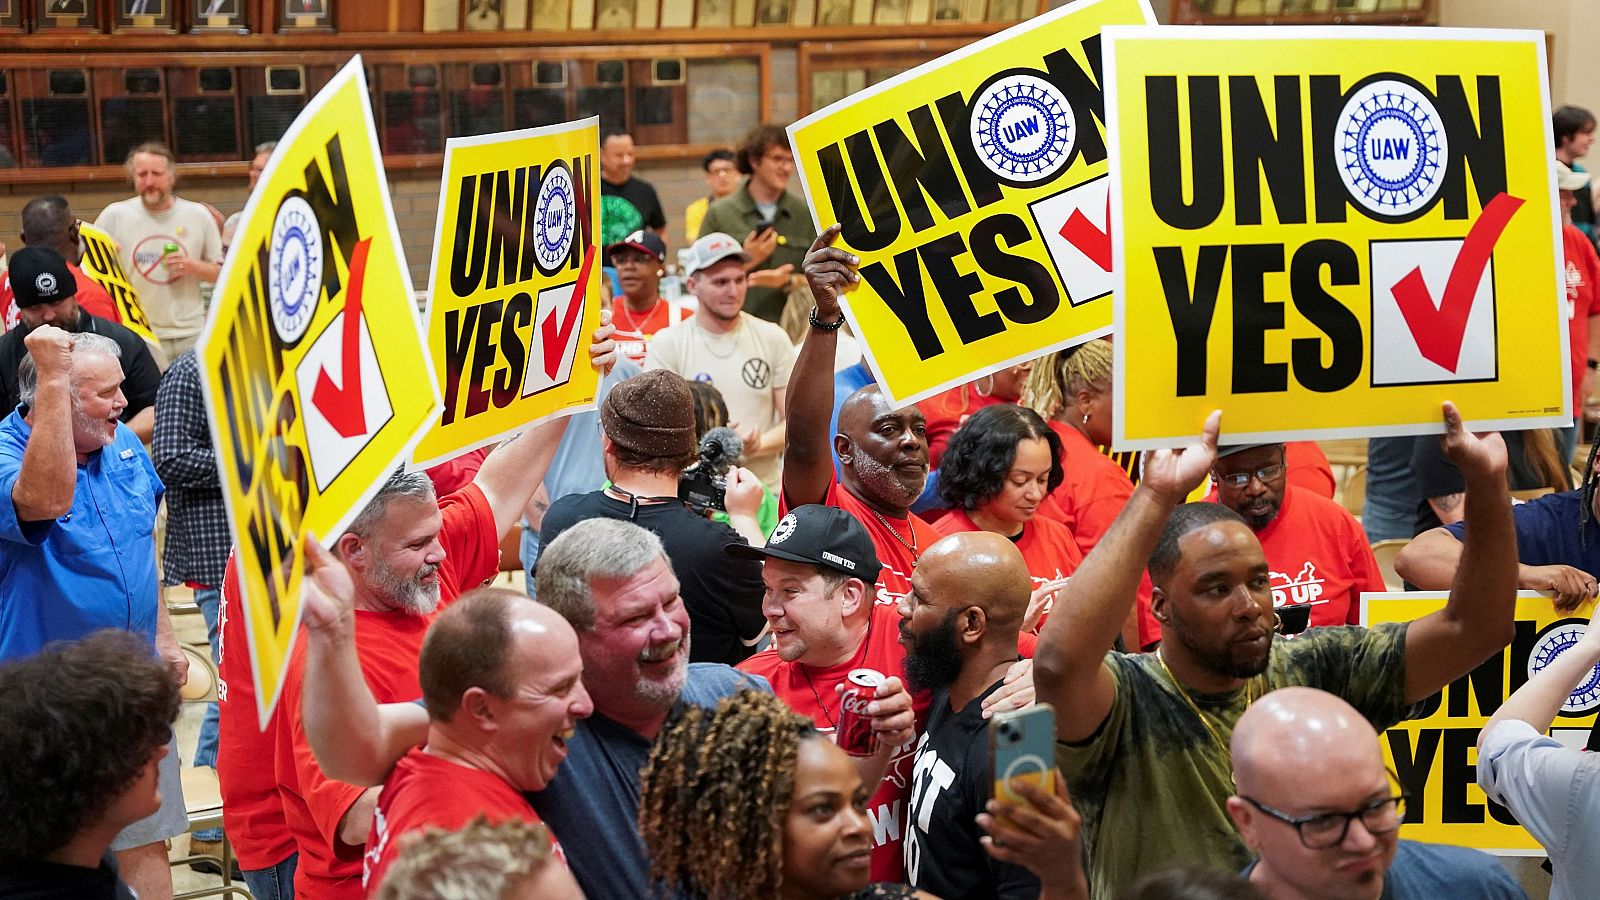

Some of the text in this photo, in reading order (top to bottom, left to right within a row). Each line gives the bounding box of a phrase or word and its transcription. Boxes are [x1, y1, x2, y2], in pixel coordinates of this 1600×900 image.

[817, 33, 1107, 253] UNION
[1003, 115, 1039, 143] UAW
[1145, 72, 1507, 230] UNION
[1372, 138, 1410, 160] UAW
[450, 154, 592, 298] UNION
[548, 209, 563, 229] UAW
[859, 213, 1060, 361] YES
[1153, 238, 1363, 397] YES
[441, 292, 532, 427] YES
[822, 551, 856, 570] UNION YES
[1291, 583, 1323, 604] UP
